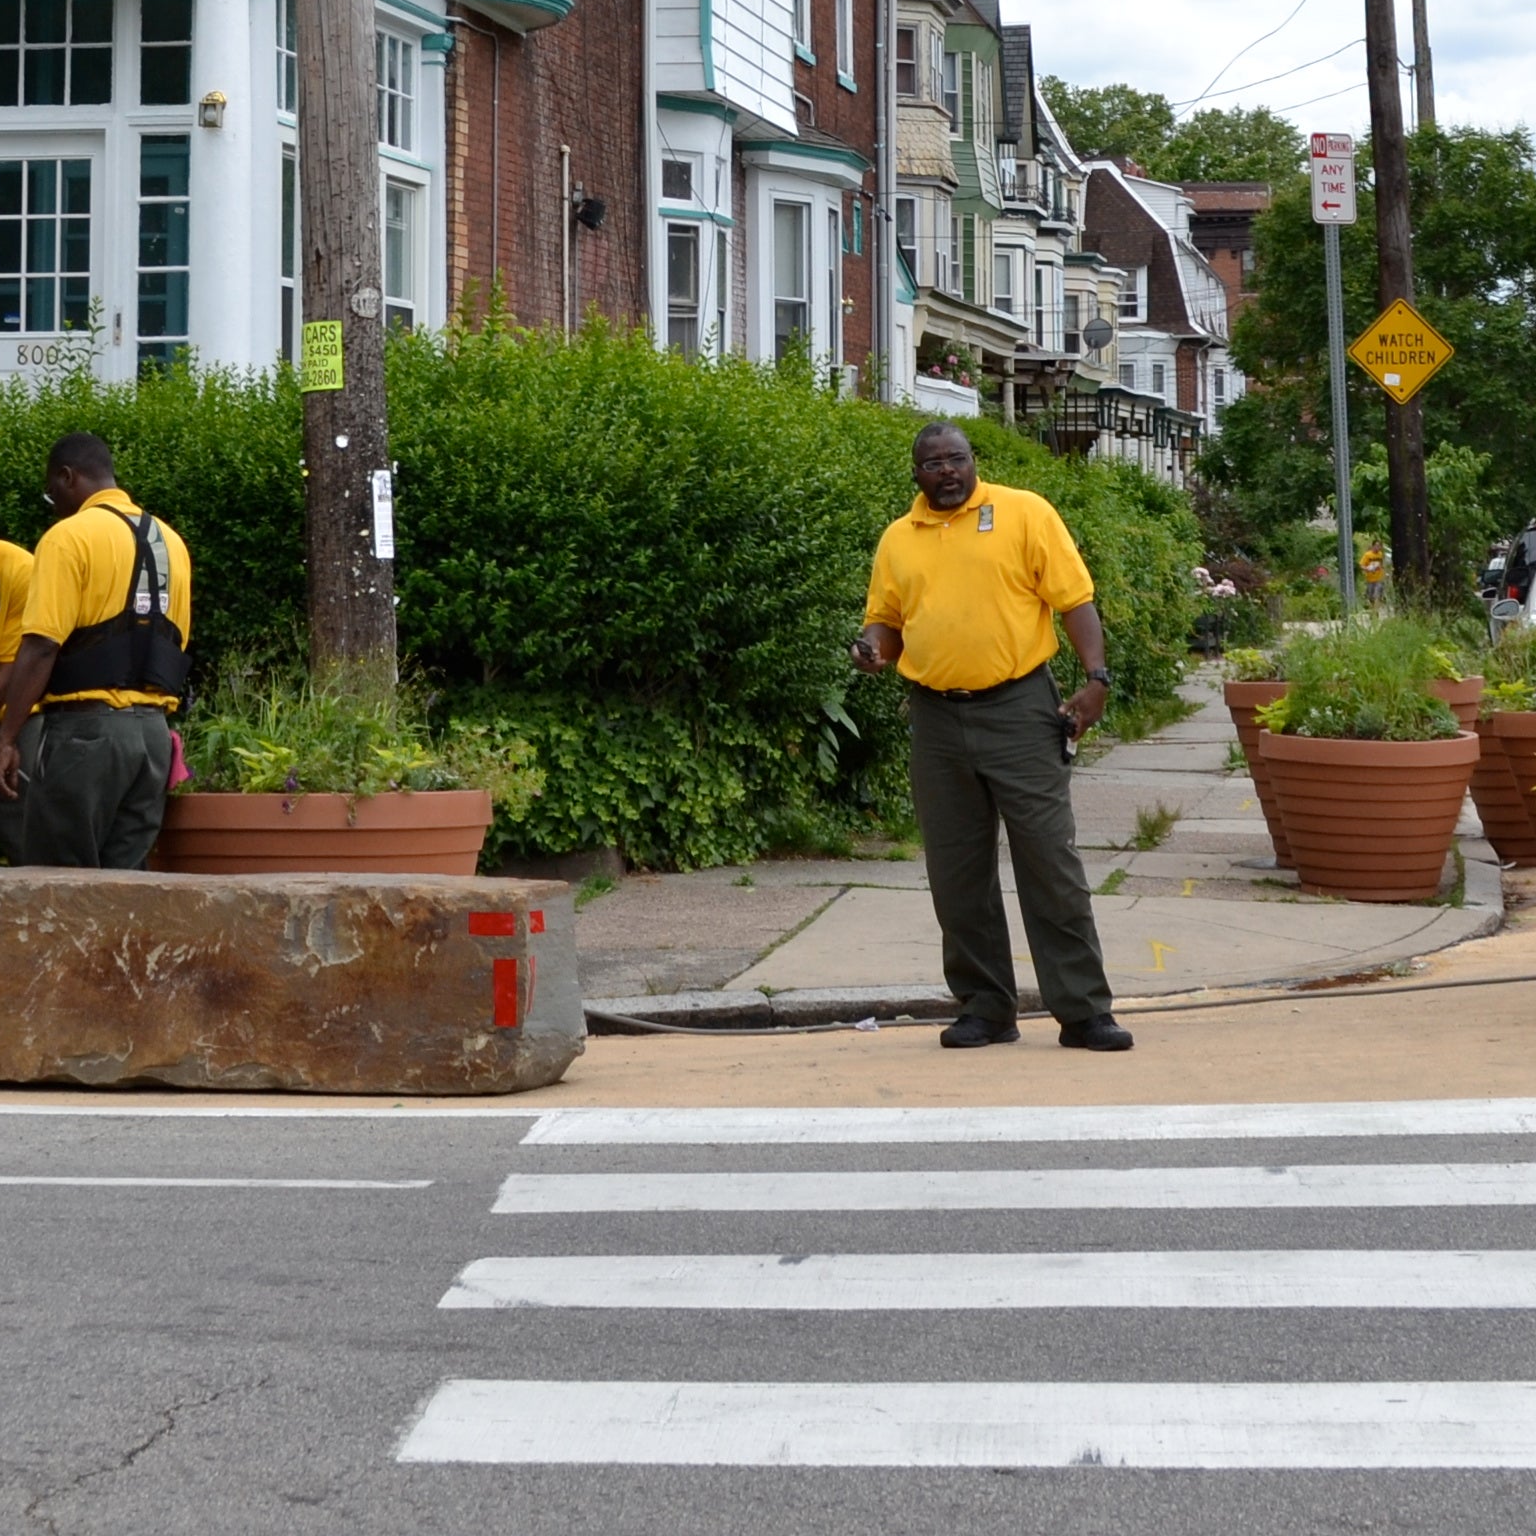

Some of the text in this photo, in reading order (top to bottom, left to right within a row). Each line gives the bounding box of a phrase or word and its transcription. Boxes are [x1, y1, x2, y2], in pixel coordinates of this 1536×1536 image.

[1312, 136, 1326, 154] NO
[1321, 164, 1344, 176] ANY
[1321, 182, 1346, 194] TIME
[305, 324, 337, 344] CARS
[1378, 333, 1424, 347] WATCH
[17, 344, 58, 365] 800
[309, 344, 338, 357] $450
[1366, 350, 1436, 365] CHILDREN
[307, 358, 329, 368] PAID
